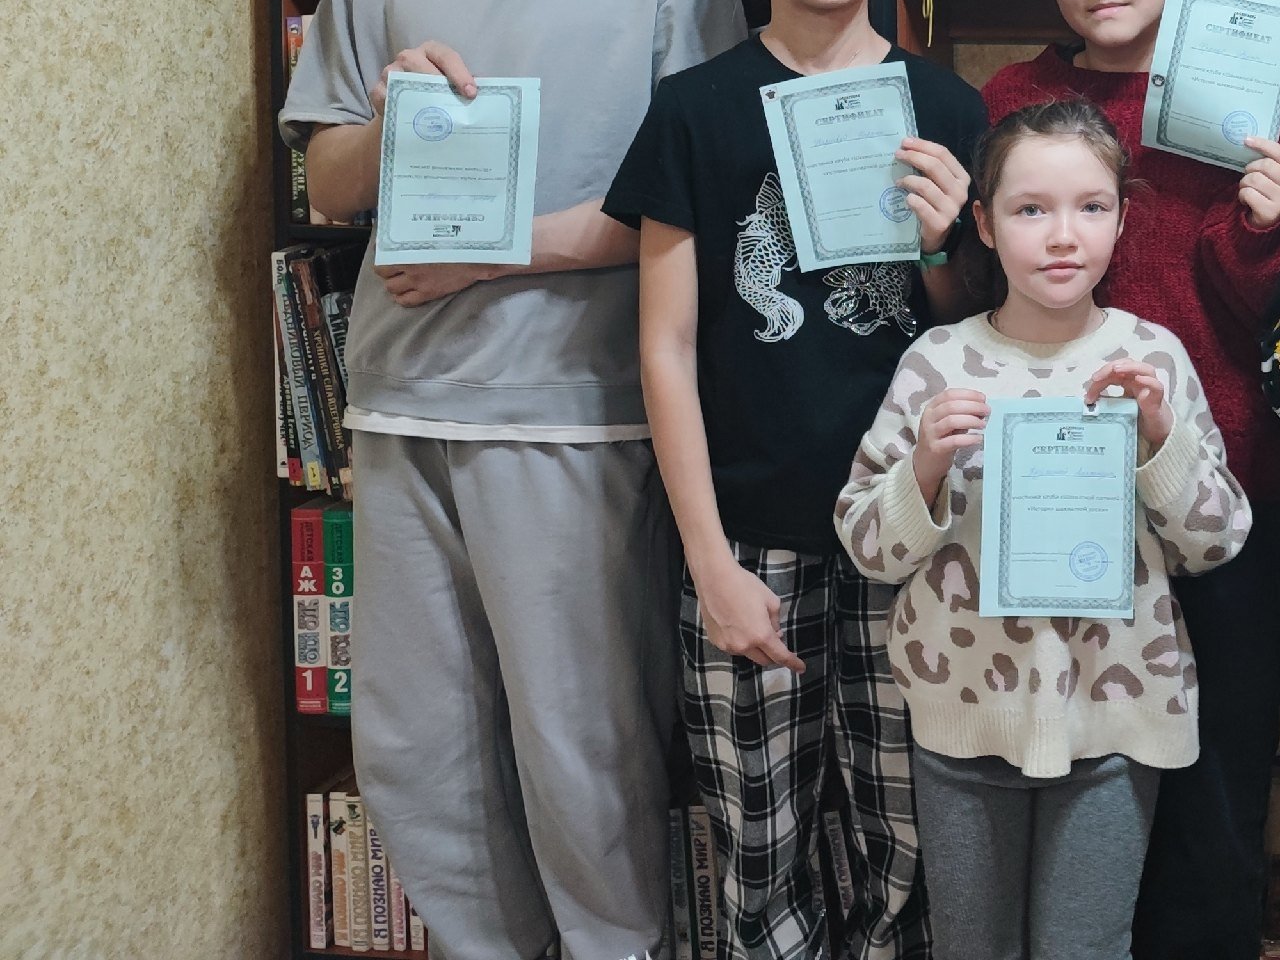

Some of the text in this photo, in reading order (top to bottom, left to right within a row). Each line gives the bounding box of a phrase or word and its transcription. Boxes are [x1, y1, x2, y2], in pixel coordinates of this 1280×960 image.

[313, 329, 345, 450] ХРОНИКИ СПАЙДЕРВИКА
[298, 395, 315, 451] ПЕРИОД
[298, 579, 317, 592] Ж
[300, 565, 312, 578] А
[302, 670, 312, 691] 1
[334, 672, 349, 693] 2
[348, 831, 363, 861] МИР
[349, 866, 366, 925] ПОЗНАЮ
[371, 865, 387, 924] ПОЗНАЮ
[694, 838, 714, 952] Я ПОЗНАЮ МИР
[374, 929, 387, 939] Я
